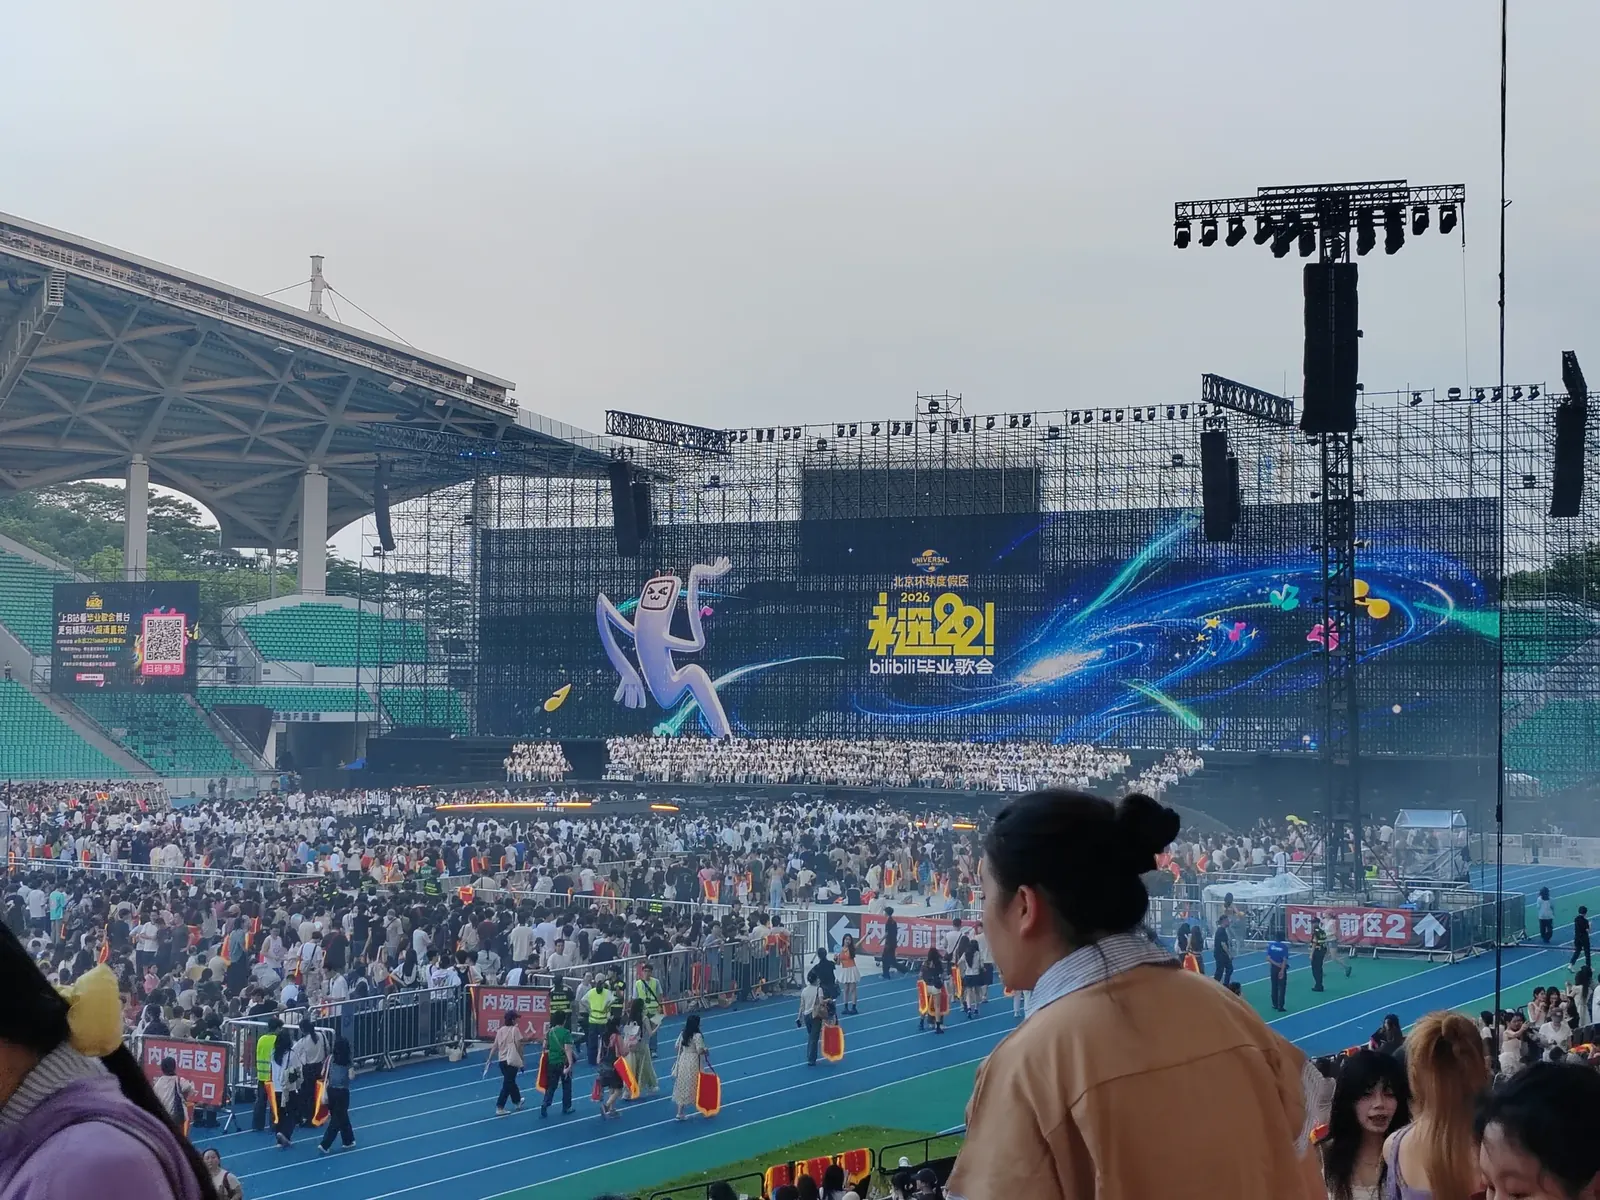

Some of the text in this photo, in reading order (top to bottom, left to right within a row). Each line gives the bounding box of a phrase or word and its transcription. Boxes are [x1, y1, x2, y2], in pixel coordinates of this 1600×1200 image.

[911, 556, 950, 565] UNIVERSAL
[893, 575, 969, 587] 北京环球度假区
[901, 592, 930, 602] 2026
[146, 664, 181, 673] 扫码参与
[482, 993, 547, 1013] 内场后区
